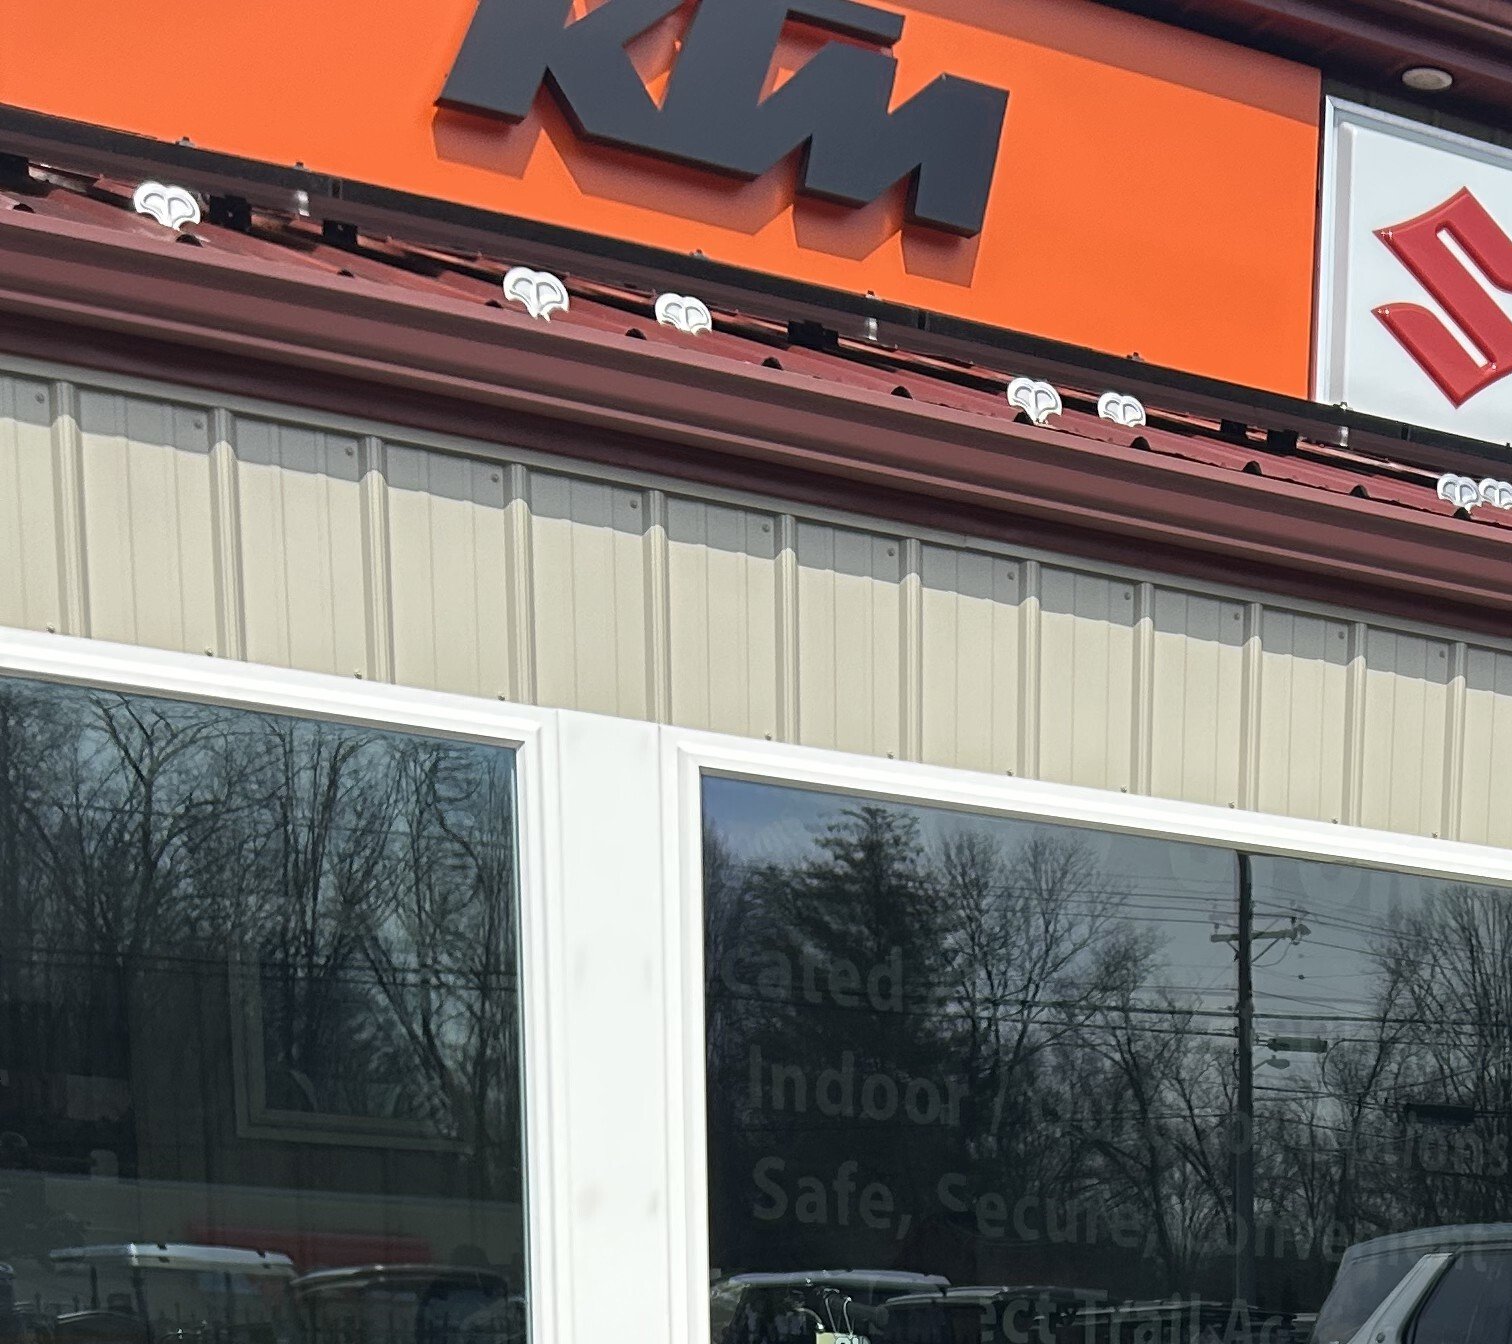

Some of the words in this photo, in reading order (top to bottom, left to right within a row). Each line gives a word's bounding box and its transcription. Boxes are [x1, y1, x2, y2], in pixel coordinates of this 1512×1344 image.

[434, 0, 1008, 237] KTM
[749, 1042, 968, 1127] Indoor
[752, 1155, 912, 1242] Safe,
